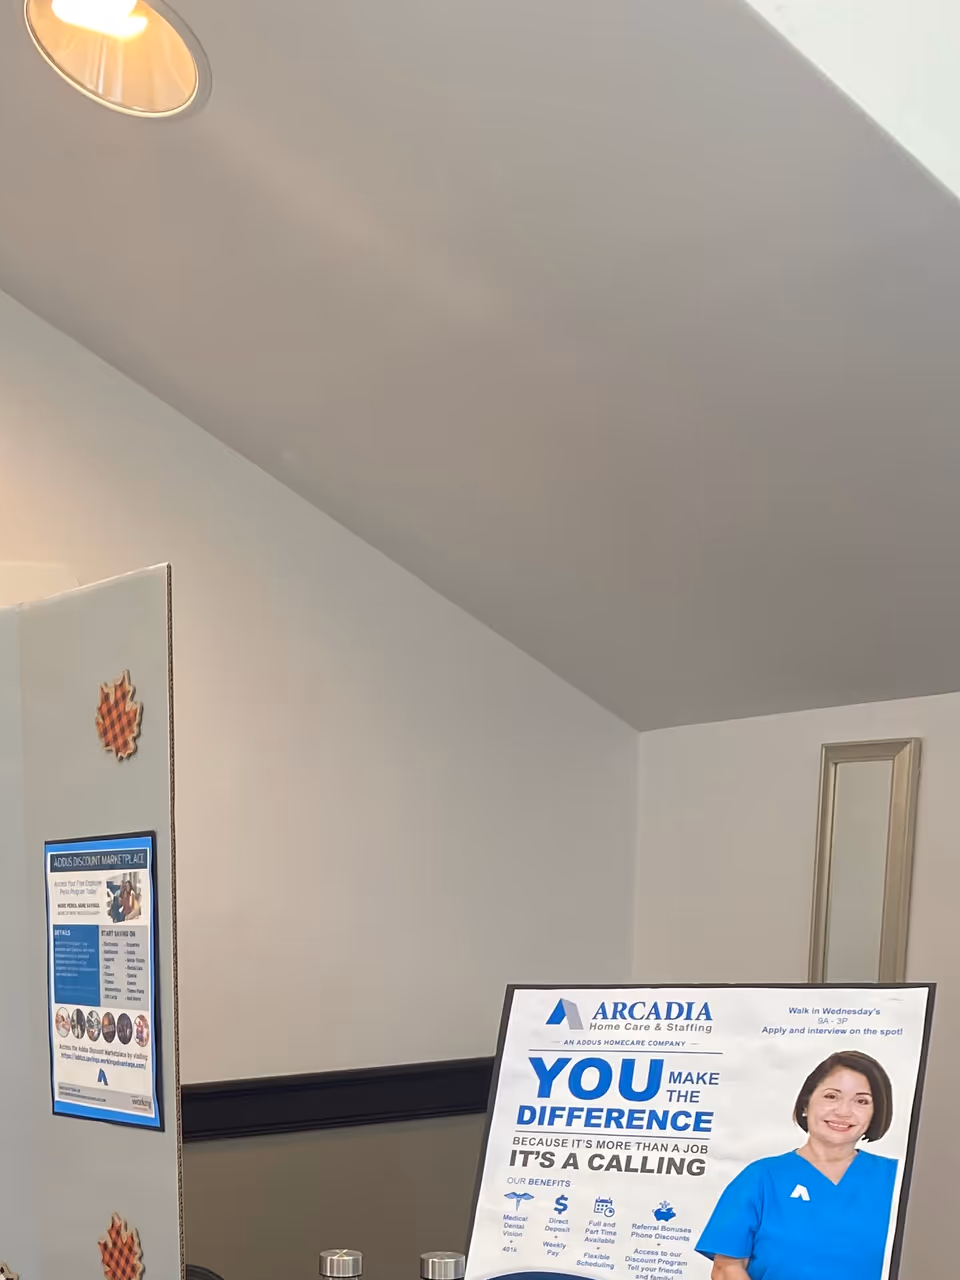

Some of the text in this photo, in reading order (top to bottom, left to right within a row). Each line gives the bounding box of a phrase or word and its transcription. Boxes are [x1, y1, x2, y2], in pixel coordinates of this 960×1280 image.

[592, 1001, 713, 1020] ARCADIA
[823, 1008, 880, 1016] Wednesday's
[624, 1023, 650, 1031] Care
[655, 1023, 662, 1031] &
[667, 1023, 712, 1034] Staffing
[762, 1026, 786, 1034] Apply
[880, 1028, 903, 1036] spot!
[529, 1057, 720, 1102] YOU MAKE
[666, 1090, 700, 1103] THE
[517, 1105, 714, 1132] DIFFERENCE
[513, 1137, 708, 1154] BECAUSE IT'S MORE THAN A JOB
[509, 1150, 706, 1176] IT'S A CALLING
[528, 1179, 571, 1187] BENEFITS
[503, 1214, 528, 1222] Medical
[661, 1225, 691, 1233] Bonuses
[654, 1233, 689, 1242] Discounts
[576, 1260, 614, 1270] Scheduling
[625, 1256, 687, 1267] Discount Program
